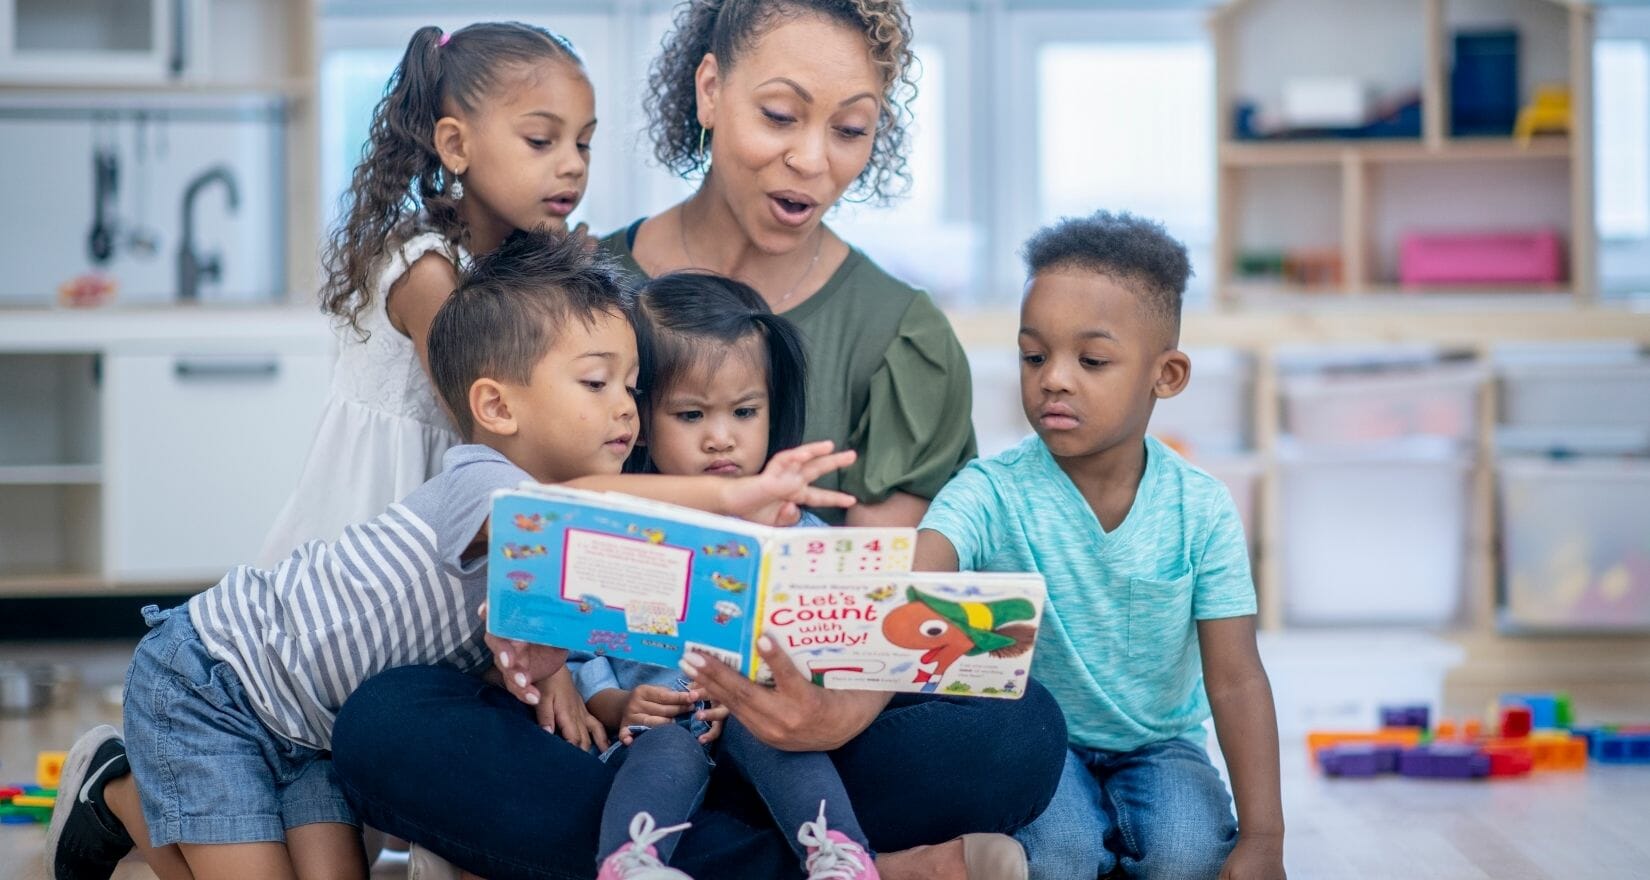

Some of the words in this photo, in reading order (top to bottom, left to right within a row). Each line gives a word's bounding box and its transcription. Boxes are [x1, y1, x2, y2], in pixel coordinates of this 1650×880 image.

[778, 543, 791, 556] 1
[806, 540, 825, 554] 2
[835, 539, 853, 553] 3
[863, 538, 881, 552] 4
[798, 591, 856, 607] Let's
[769, 604, 878, 626] Count
[799, 622, 843, 634] with
[787, 631, 869, 648] Lowly!
